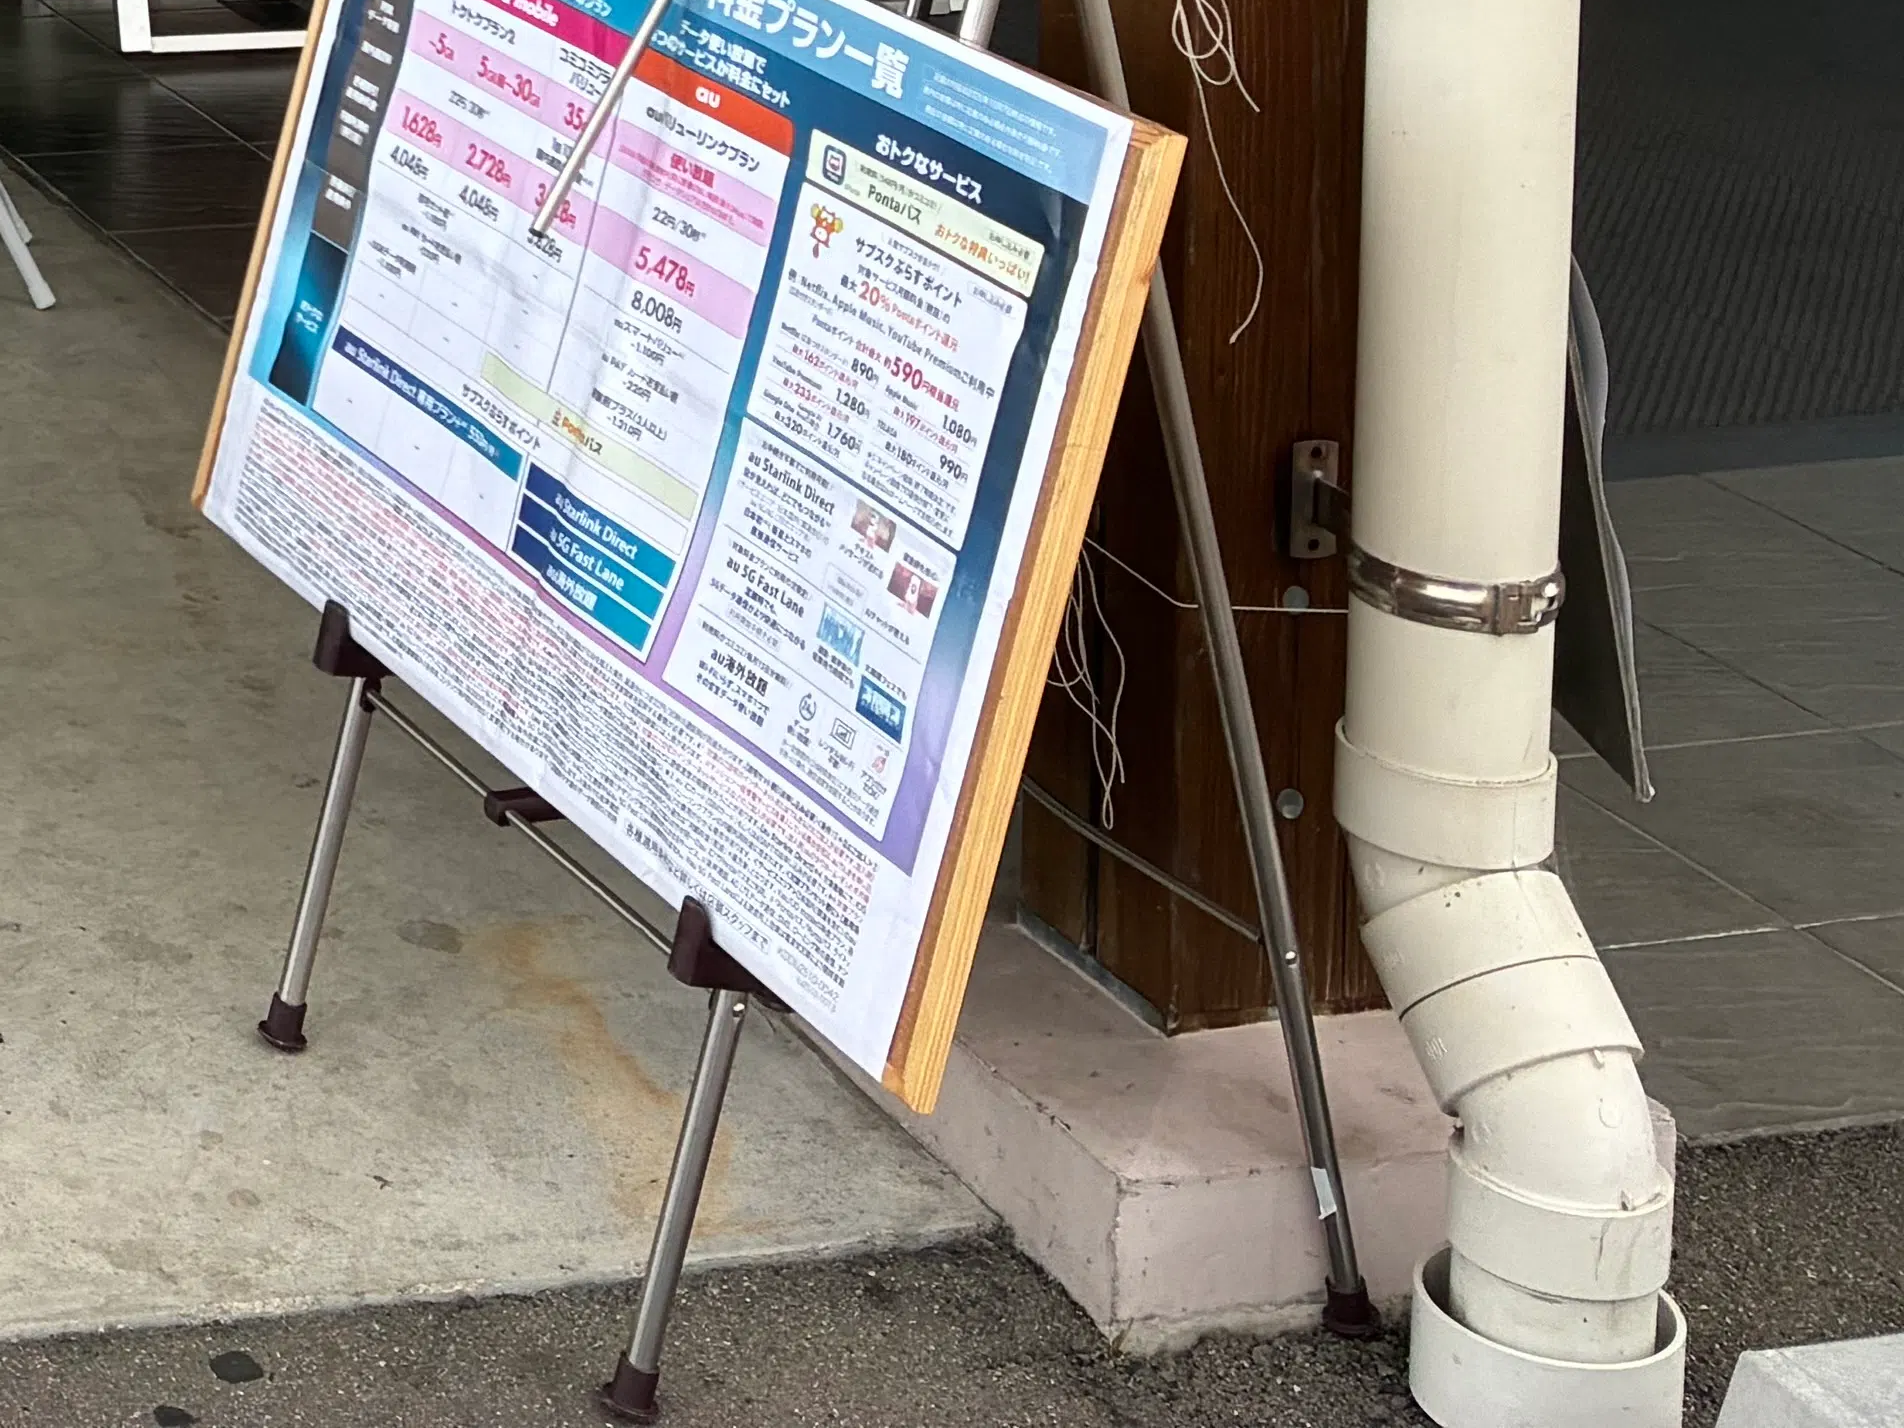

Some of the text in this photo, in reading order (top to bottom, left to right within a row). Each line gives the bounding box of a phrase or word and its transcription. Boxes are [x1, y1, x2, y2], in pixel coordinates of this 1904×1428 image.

[651, 27, 792, 111] つのサービスが料金にセット
[693, 84, 721, 111] au
[874, 132, 985, 205] おトクなサービス
[867, 183, 922, 225] Pontaパス
[633, 240, 697, 300] 5,478円
[630, 286, 684, 335] 8,008円
[850, 356, 880, 385] 890円
[761, 457, 803, 494] Starlink
[802, 483, 835, 516] Direct
[937, 452, 969, 484] 990円
[561, 497, 602, 536] Starlink
[600, 524, 638, 561] Direct
[555, 531, 570, 553] 5G
[569, 541, 595, 572] Fast
[594, 559, 624, 592] Lane
[726, 556, 805, 618] au 5G Fast Lane
[709, 644, 768, 698] au海外放題
